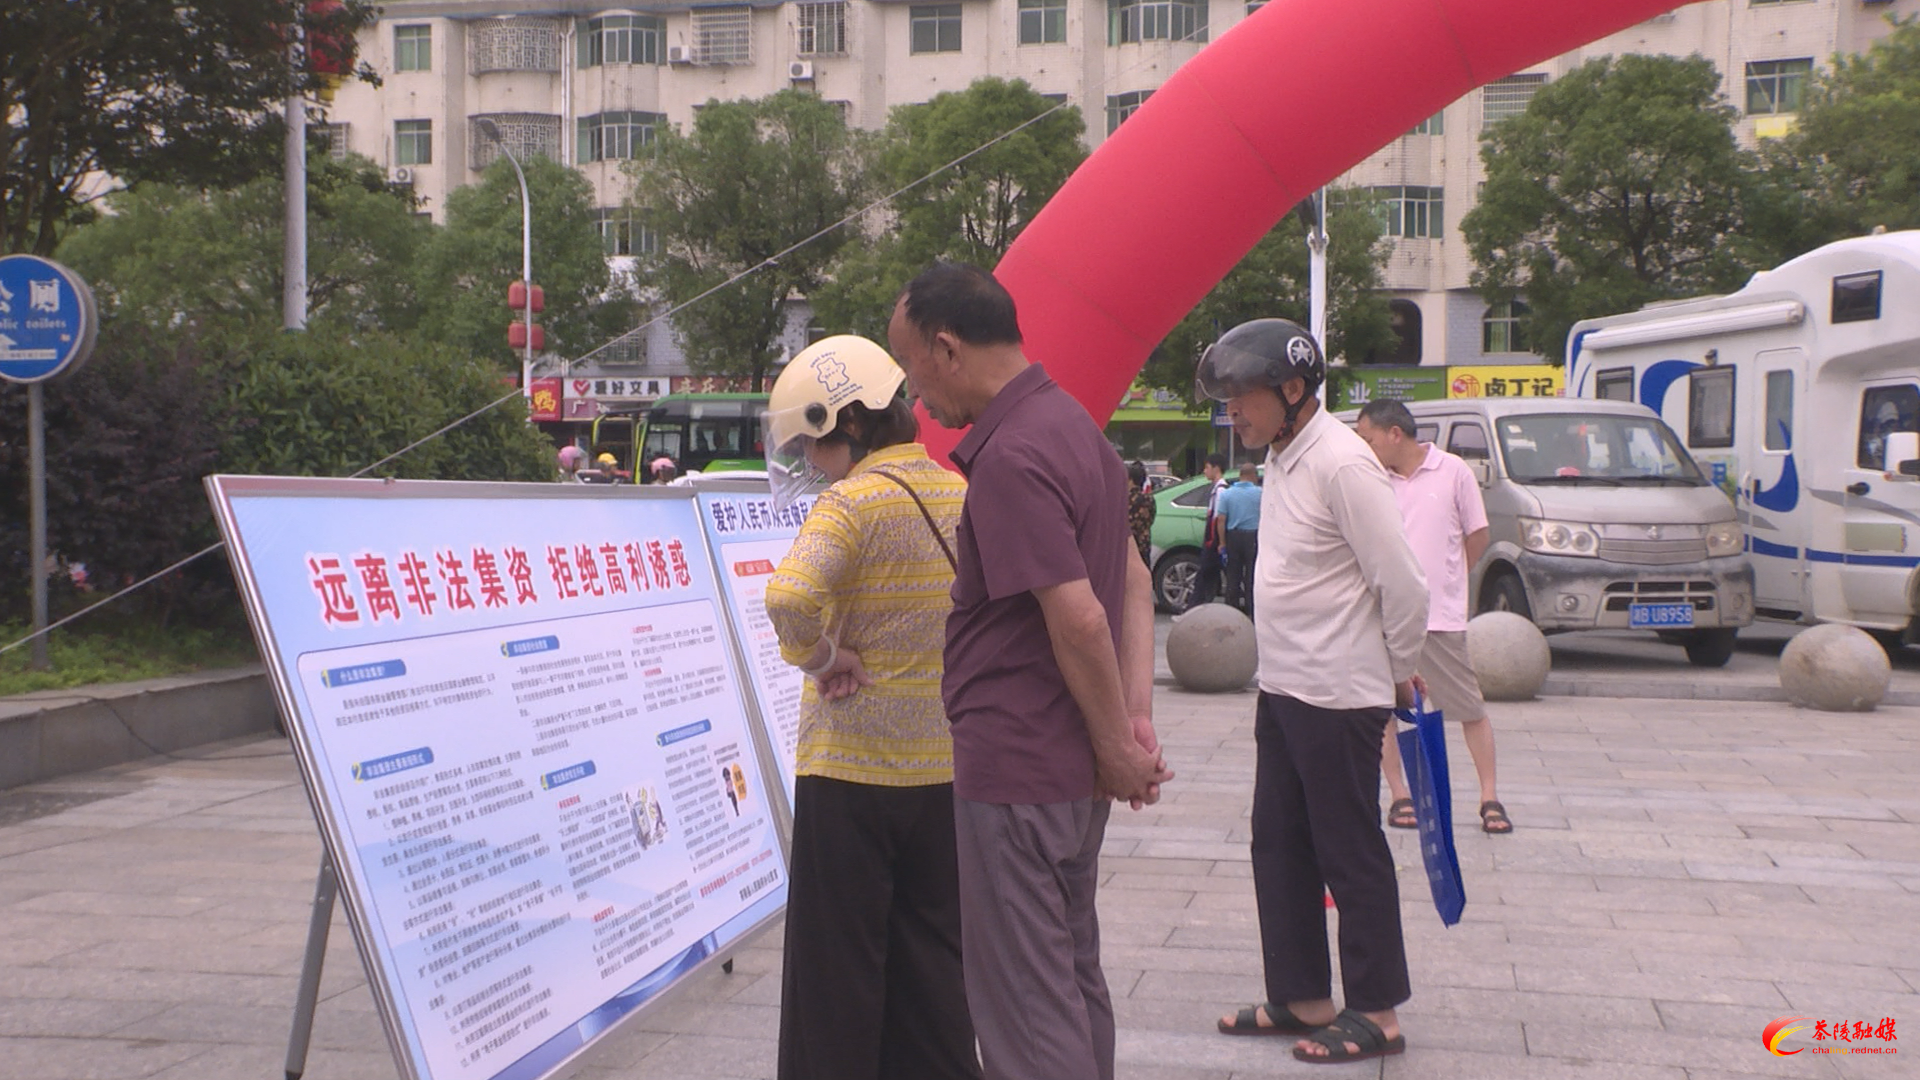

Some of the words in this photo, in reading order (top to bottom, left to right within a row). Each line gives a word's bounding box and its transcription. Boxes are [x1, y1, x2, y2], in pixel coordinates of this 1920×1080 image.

[26, 318, 67, 329] toilets
[1485, 377, 1555, 397] 卤丁记
[309, 546, 538, 624] 远离非法集资
[547, 539, 691, 600] 拒绝高利诱惑
[352, 762, 364, 784] 2
